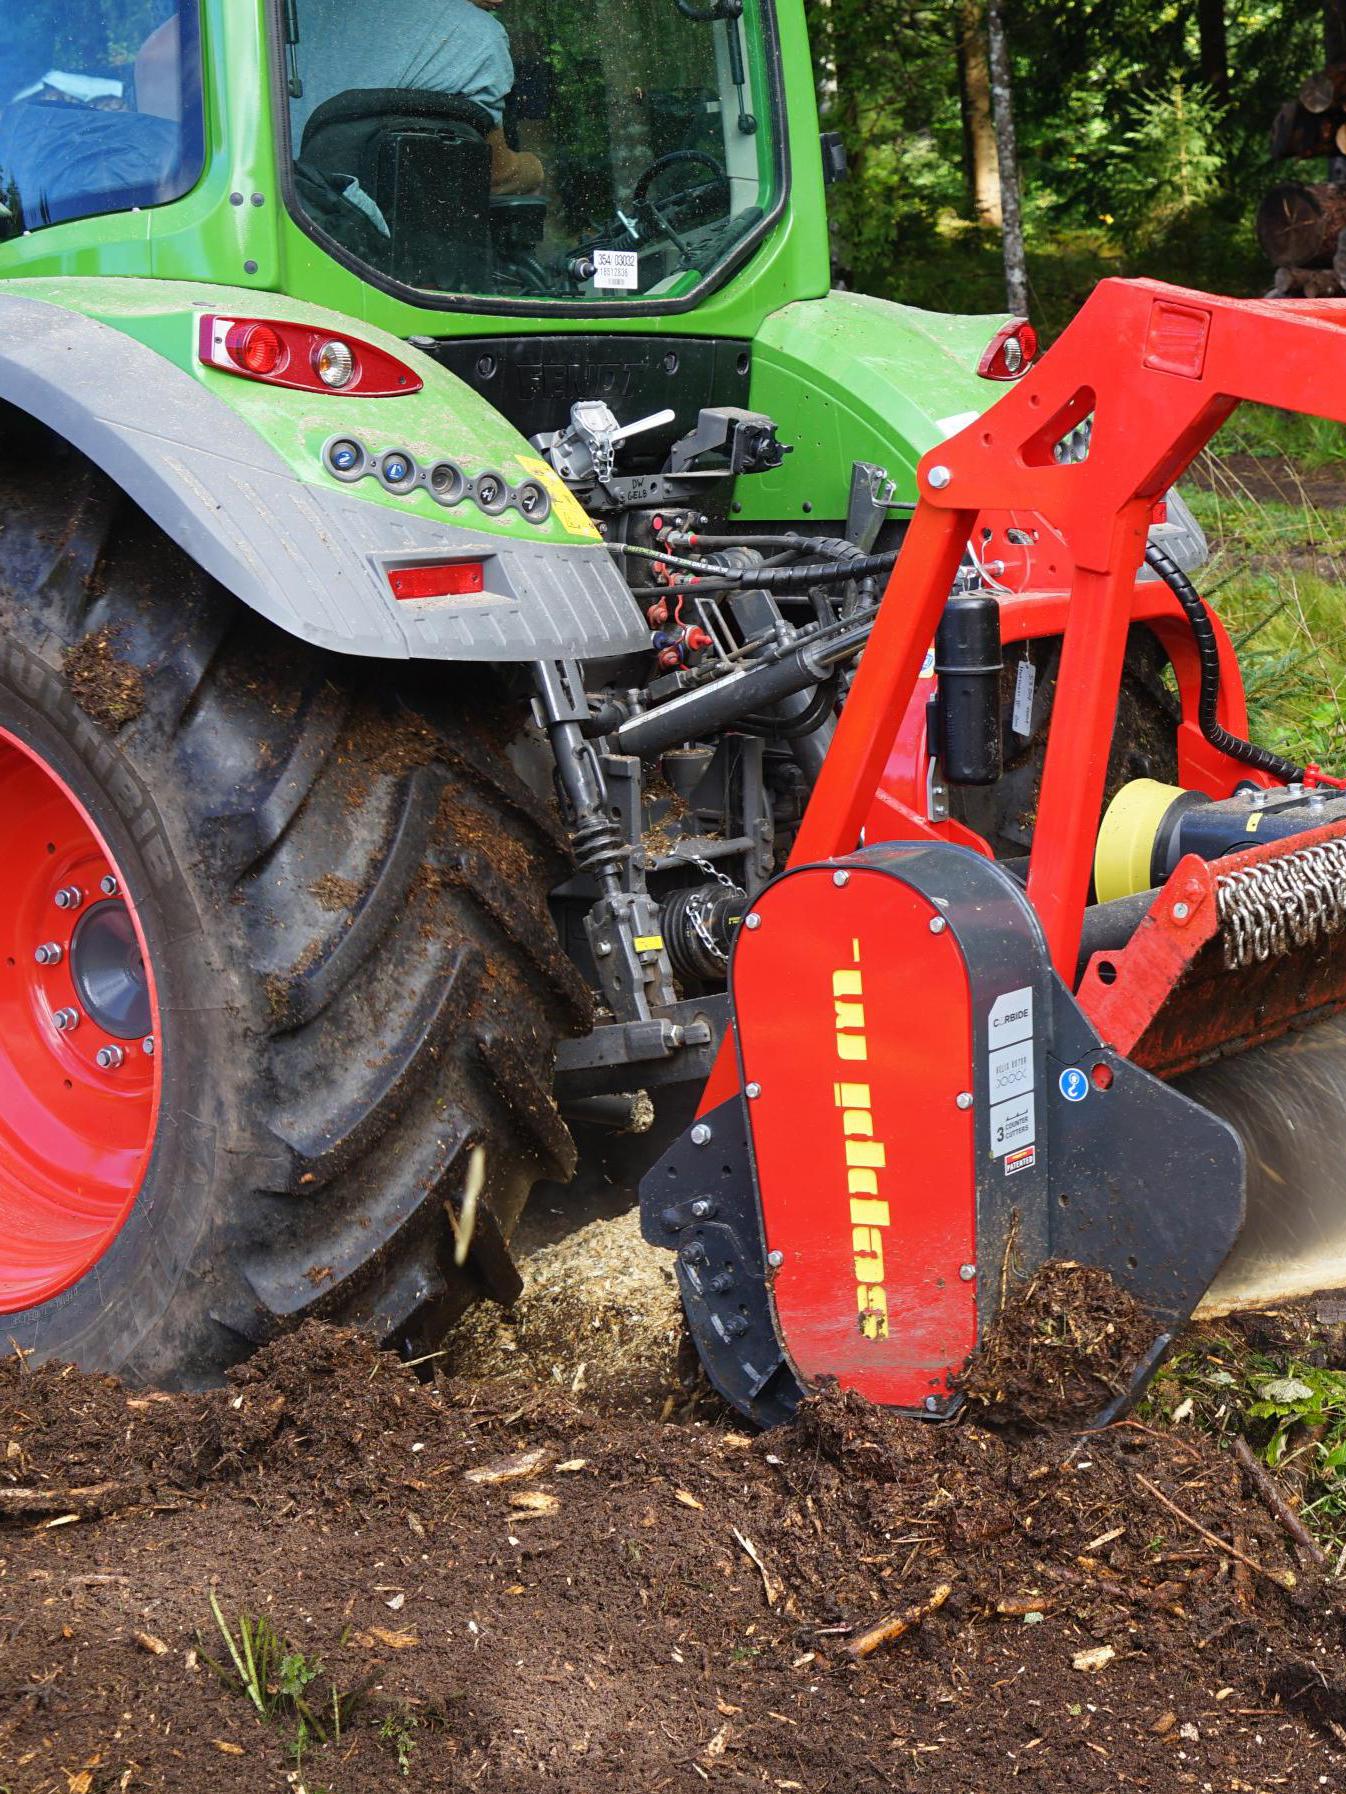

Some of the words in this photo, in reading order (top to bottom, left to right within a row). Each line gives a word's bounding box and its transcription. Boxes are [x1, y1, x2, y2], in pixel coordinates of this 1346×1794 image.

[6, 648, 175, 883] ULTIBIB
[833, 1082, 891, 1343] seppi
[996, 1127, 1005, 1142] 3
